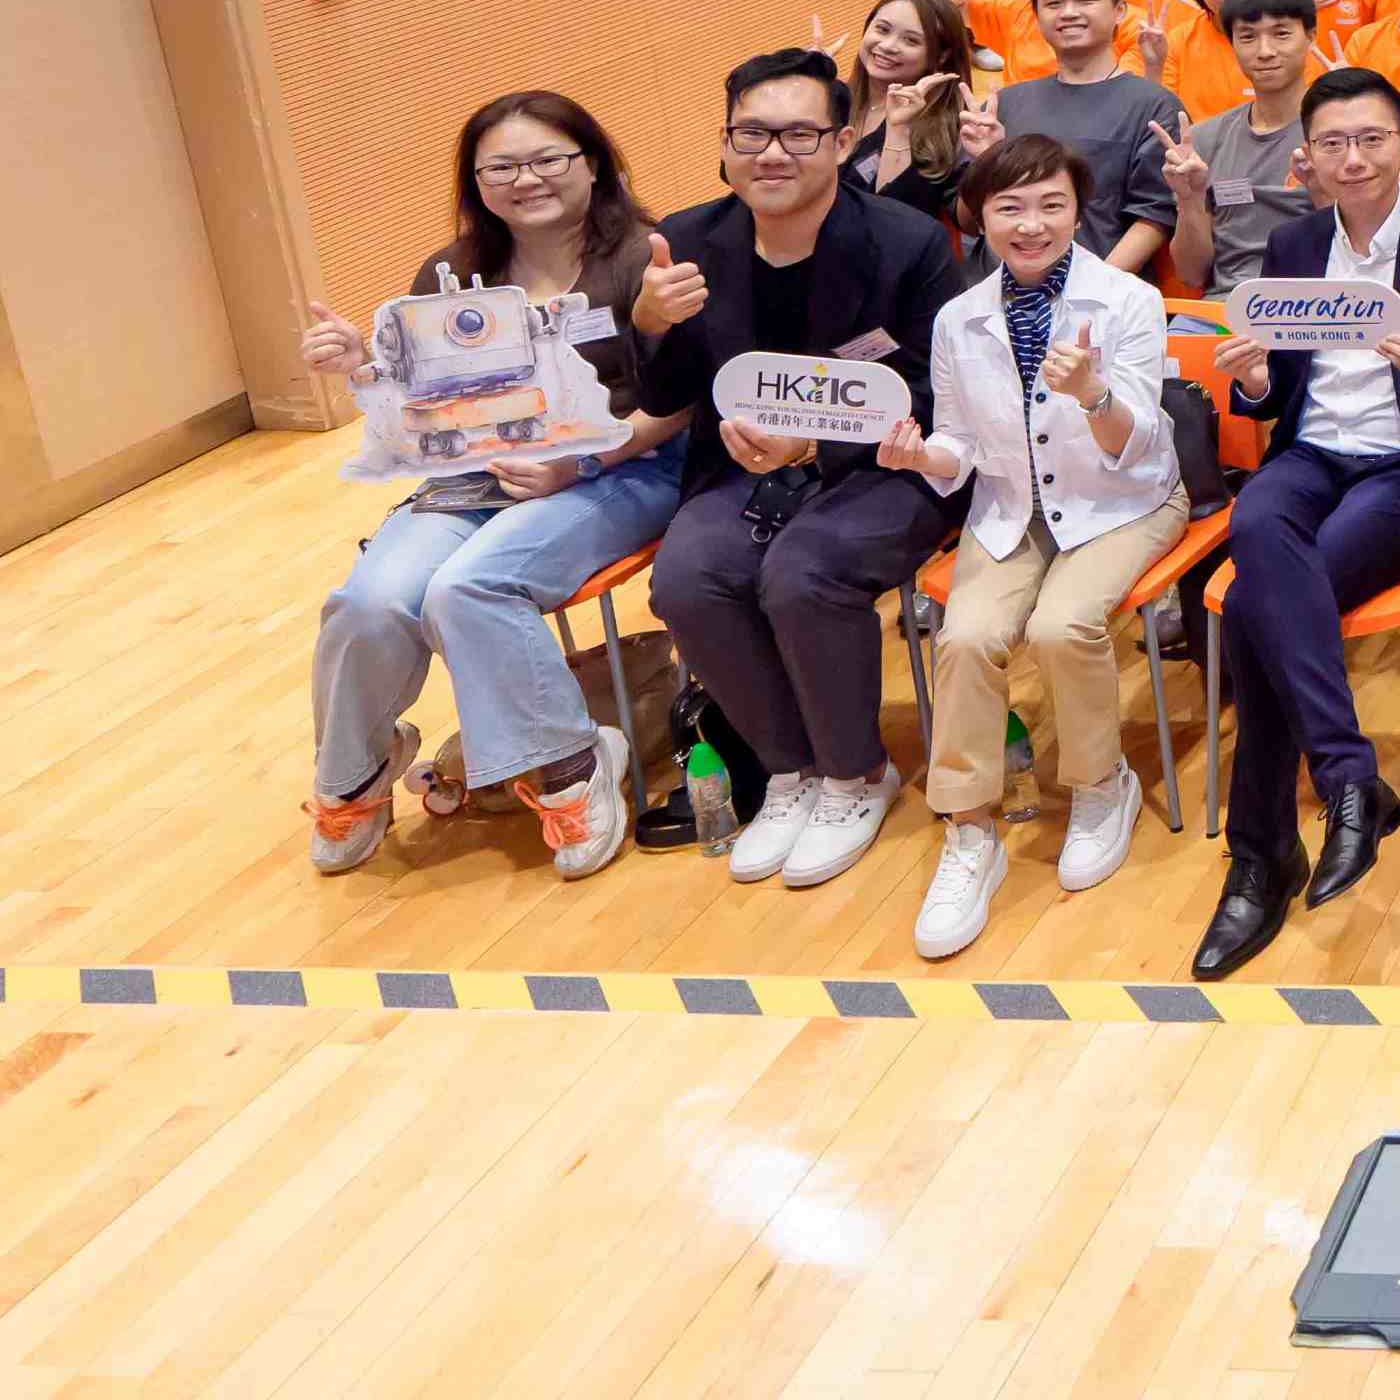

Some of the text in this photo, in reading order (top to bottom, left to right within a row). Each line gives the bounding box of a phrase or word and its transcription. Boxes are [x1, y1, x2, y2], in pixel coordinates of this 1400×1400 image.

[1246, 291, 1384, 320] Generation
[1287, 331, 1317, 341] HONG
[1321, 331, 1351, 341] KONG
